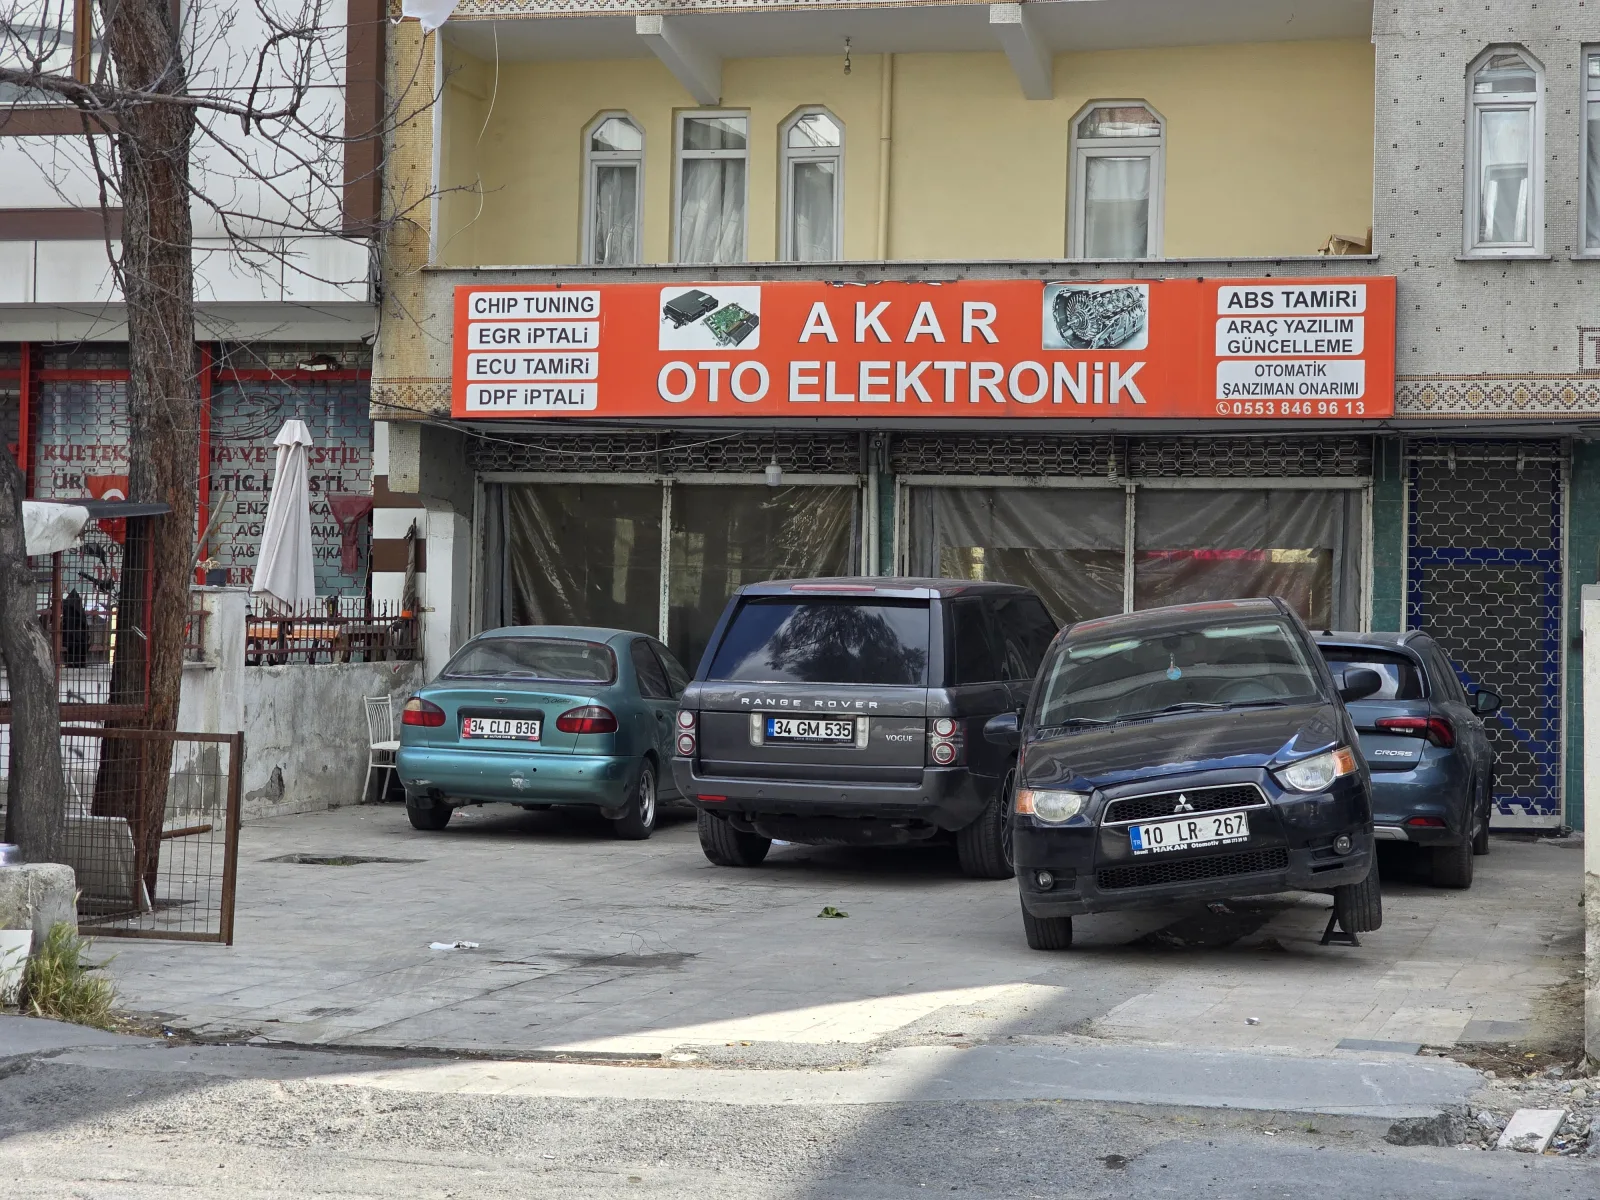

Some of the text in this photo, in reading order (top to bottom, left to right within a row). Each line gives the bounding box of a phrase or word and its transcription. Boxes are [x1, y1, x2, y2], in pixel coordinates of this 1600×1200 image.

[474, 296, 595, 315] CHIP TUNING
[1227, 291, 1275, 309] ABS
[798, 301, 1000, 344] AKAR
[1227, 319, 1354, 337] ARAÇ YAZILIM
[479, 328, 522, 345] EGR
[1227, 337, 1353, 354] GÜNCELLEME
[475, 358, 517, 376] ECU
[1254, 361, 1327, 378] OTOMATİK
[657, 359, 1147, 404] OTO ELEKTRONiK
[1222, 381, 1359, 399] ŞANZIMAN ONARIMI
[479, 389, 517, 406] DPF
[1233, 402, 1365, 416] 0553 846 96 13
[741, 698, 878, 708] RANGE ROVER
[471, 720, 485, 733] 34
[490, 721, 511, 734] CLD
[515, 722, 537, 735] 836
[775, 720, 792, 736] 34
[796, 721, 820, 737] GM
[824, 722, 851, 738] 535
[885, 734, 913, 743] VOGUE
[1374, 749, 1413, 757] CROSS
[1144, 826, 1164, 846] 10
[1177, 821, 1199, 842] LR
[1212, 815, 1243, 837] 267
[1153, 843, 1187, 853] HAKAN
[1190, 840, 1220, 849] Otomotiv
